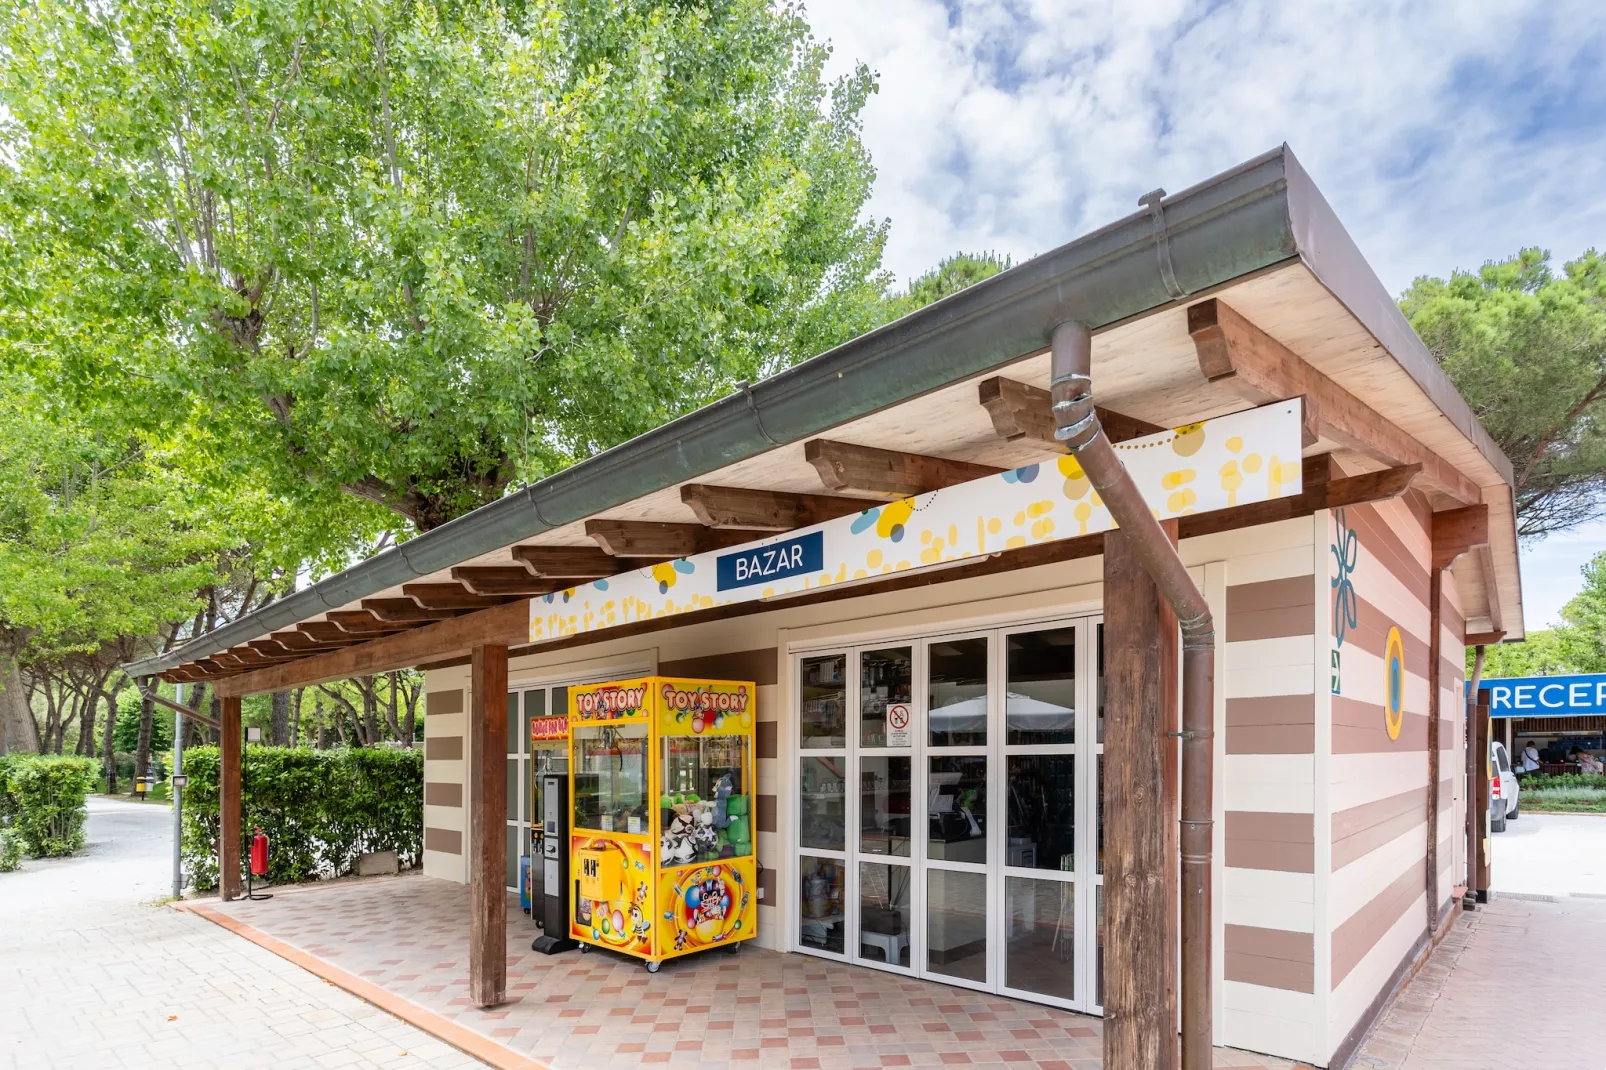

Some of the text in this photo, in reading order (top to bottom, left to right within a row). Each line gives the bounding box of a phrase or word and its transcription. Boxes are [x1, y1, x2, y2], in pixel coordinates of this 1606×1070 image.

[736, 544, 803, 581] BAZAR
[576, 687, 645, 713] TOY STORY
[665, 690, 748, 713] TOY STORY
